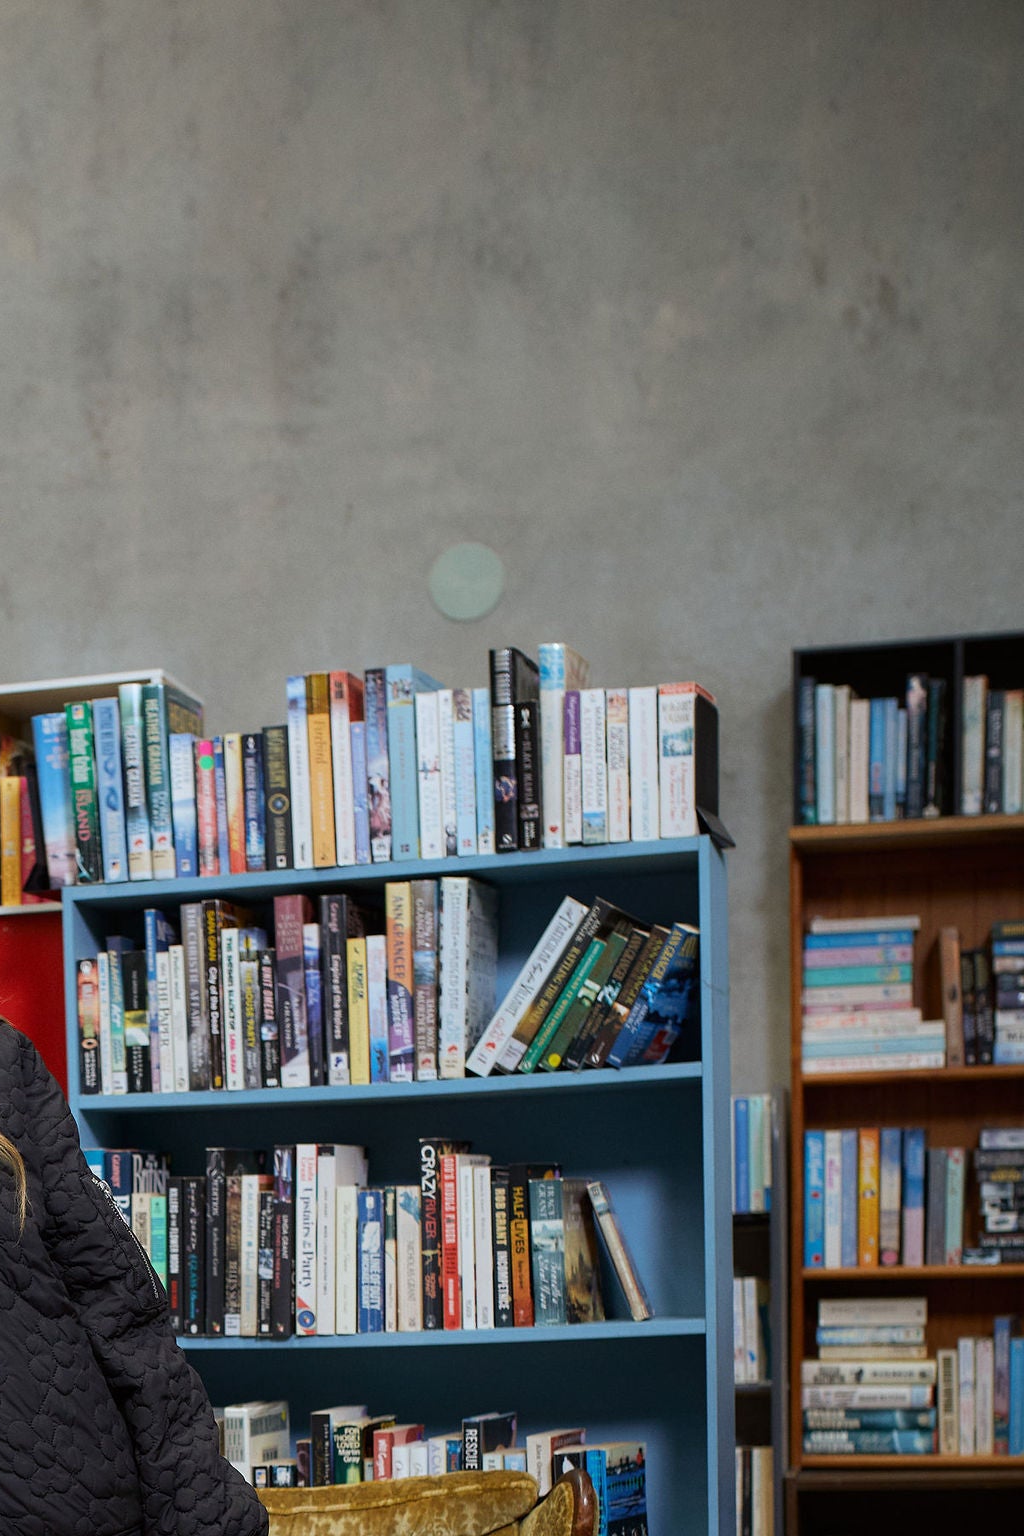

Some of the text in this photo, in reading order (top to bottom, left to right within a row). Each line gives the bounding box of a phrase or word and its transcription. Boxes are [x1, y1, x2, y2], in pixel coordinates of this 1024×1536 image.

[76, 788, 92, 842] ISLAND
[392, 895, 405, 979] ANN GRANGER
[652, 948, 676, 981] GRANGER
[208, 966, 220, 1035] City the Dead
[420, 1144, 436, 1200] CRAZY
[423, 1199, 437, 1239] RIVER
[494, 1187, 507, 1246] ROB GRANT
[513, 1186, 526, 1254] HALF LIVES
[298, 1251, 314, 1288] Party
[334, 1434, 357, 1442] THOSE
[336, 1442, 361, 1450] LOVED
[344, 1427, 360, 1435] FOR
[465, 1428, 478, 1471] RESCUE
[338, 1449, 361, 1457] Martin
[343, 1456, 361, 1465] Gray
